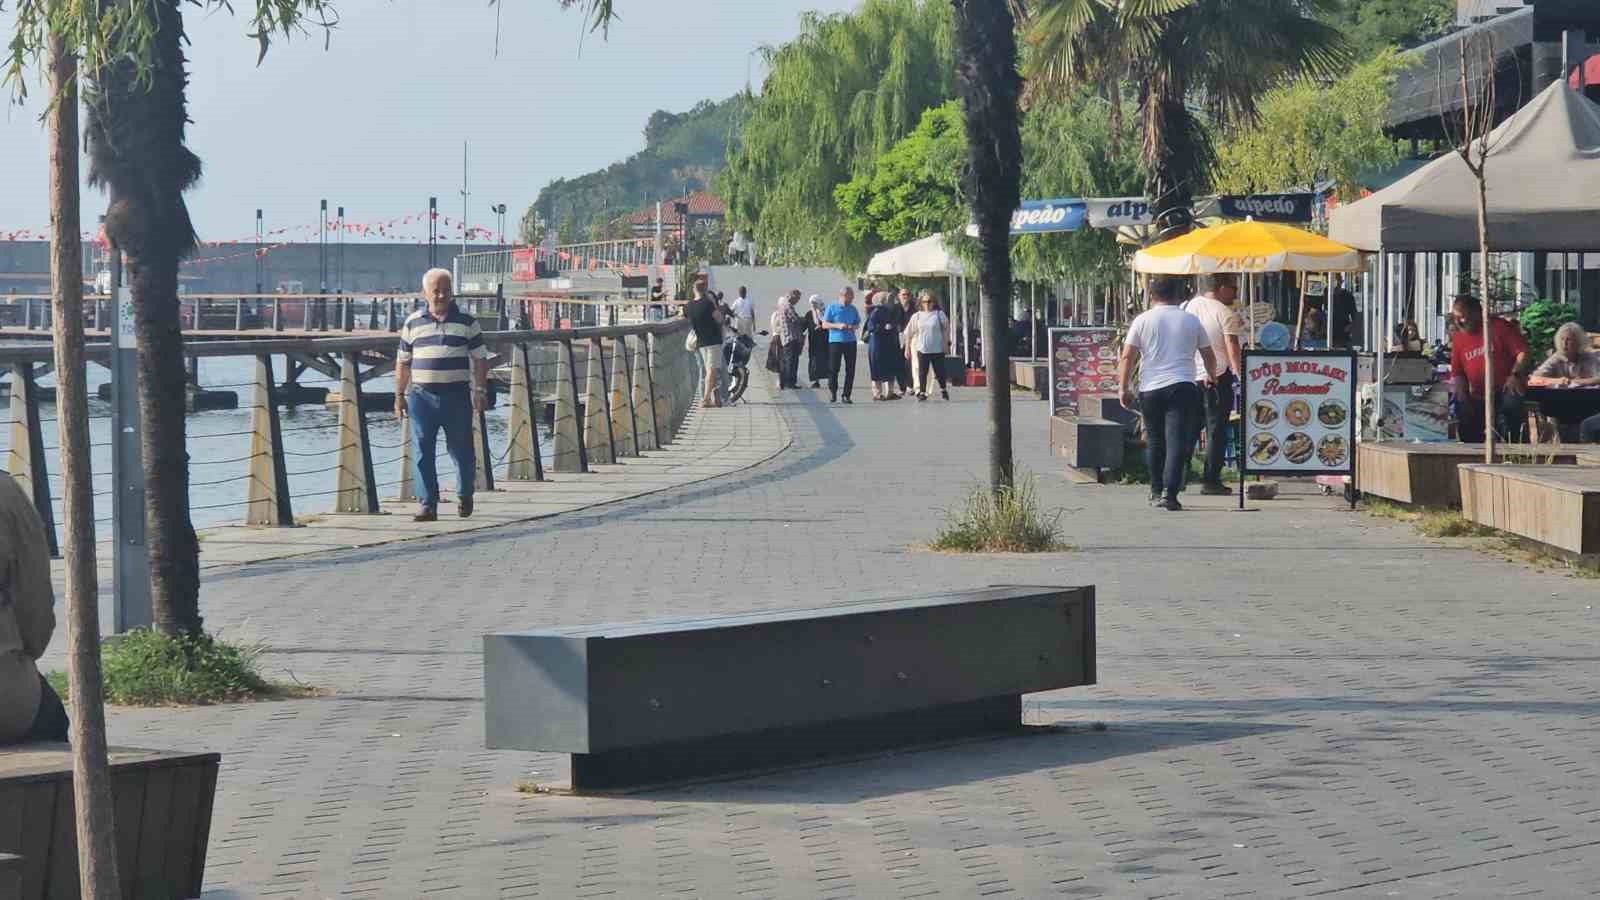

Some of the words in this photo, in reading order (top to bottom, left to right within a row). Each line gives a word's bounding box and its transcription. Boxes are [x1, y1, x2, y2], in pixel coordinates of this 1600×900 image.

[1107, 199, 1153, 220] alp
[1234, 195, 1295, 216] alpedo
[1010, 204, 1067, 229] pedo
